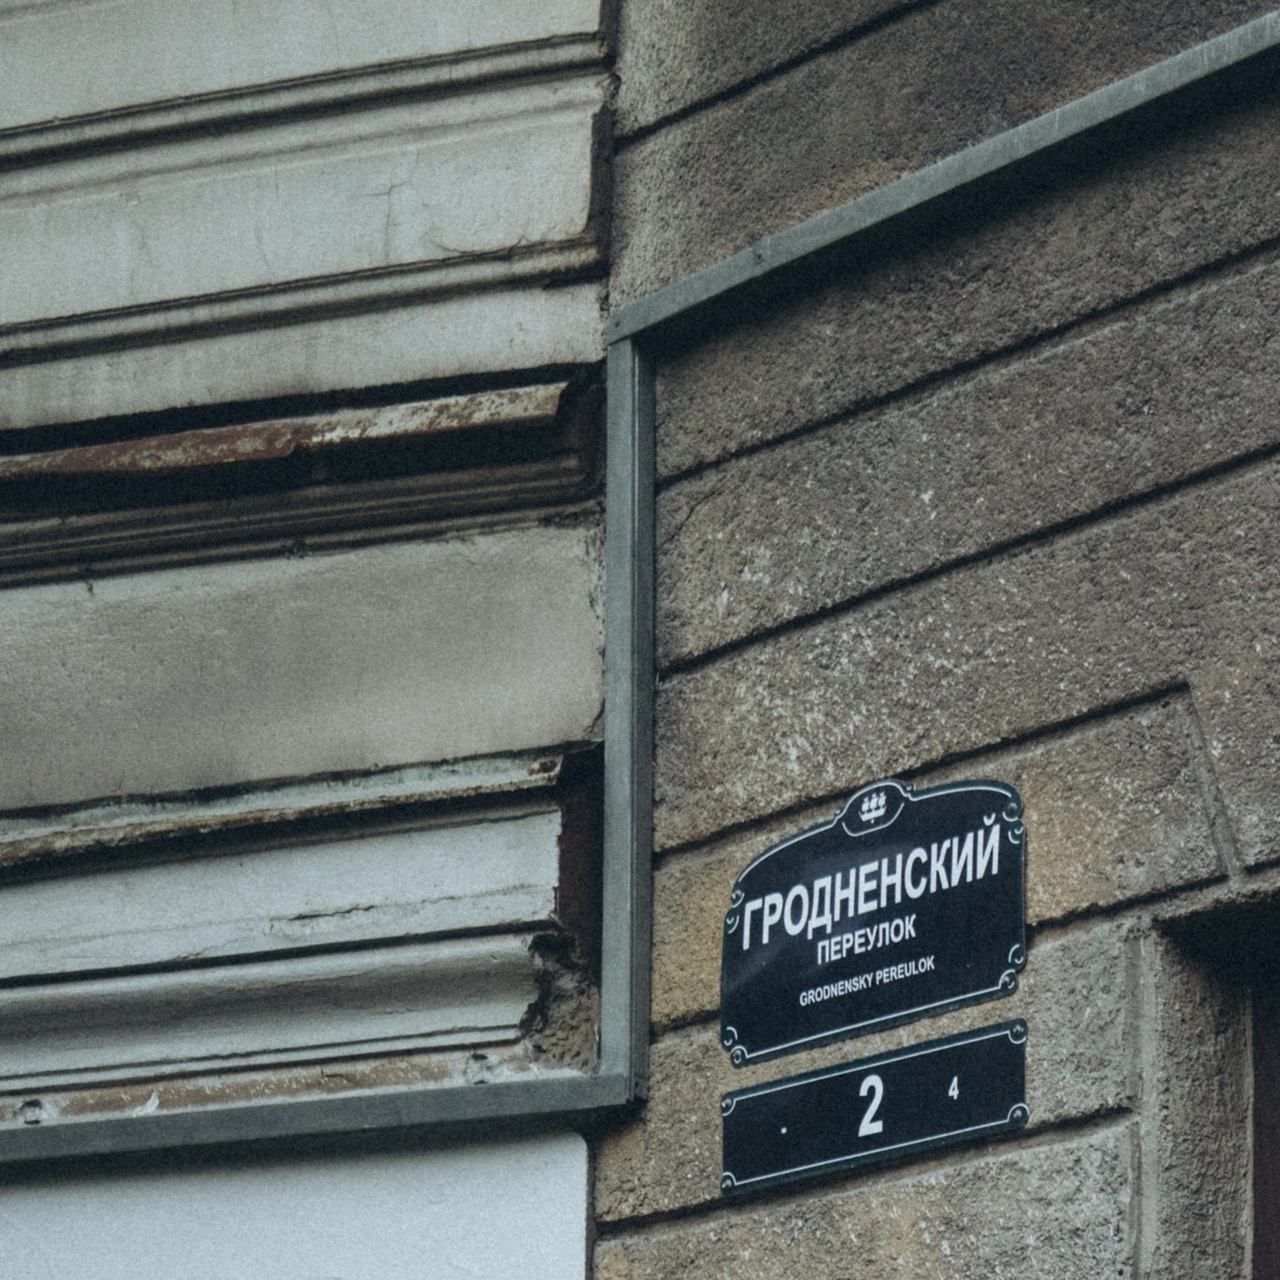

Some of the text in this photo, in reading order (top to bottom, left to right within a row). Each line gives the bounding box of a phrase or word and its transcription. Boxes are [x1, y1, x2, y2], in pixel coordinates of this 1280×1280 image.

[743, 813, 1001, 951] ГРОДНЕНСКИЙ
[817, 913, 917, 966] ПЕРЕУЛОК
[799, 954, 936, 1007] GRODNENSKY PEREULOK
[857, 1073, 885, 1138] 2
[947, 1075, 960, 1101] 4
